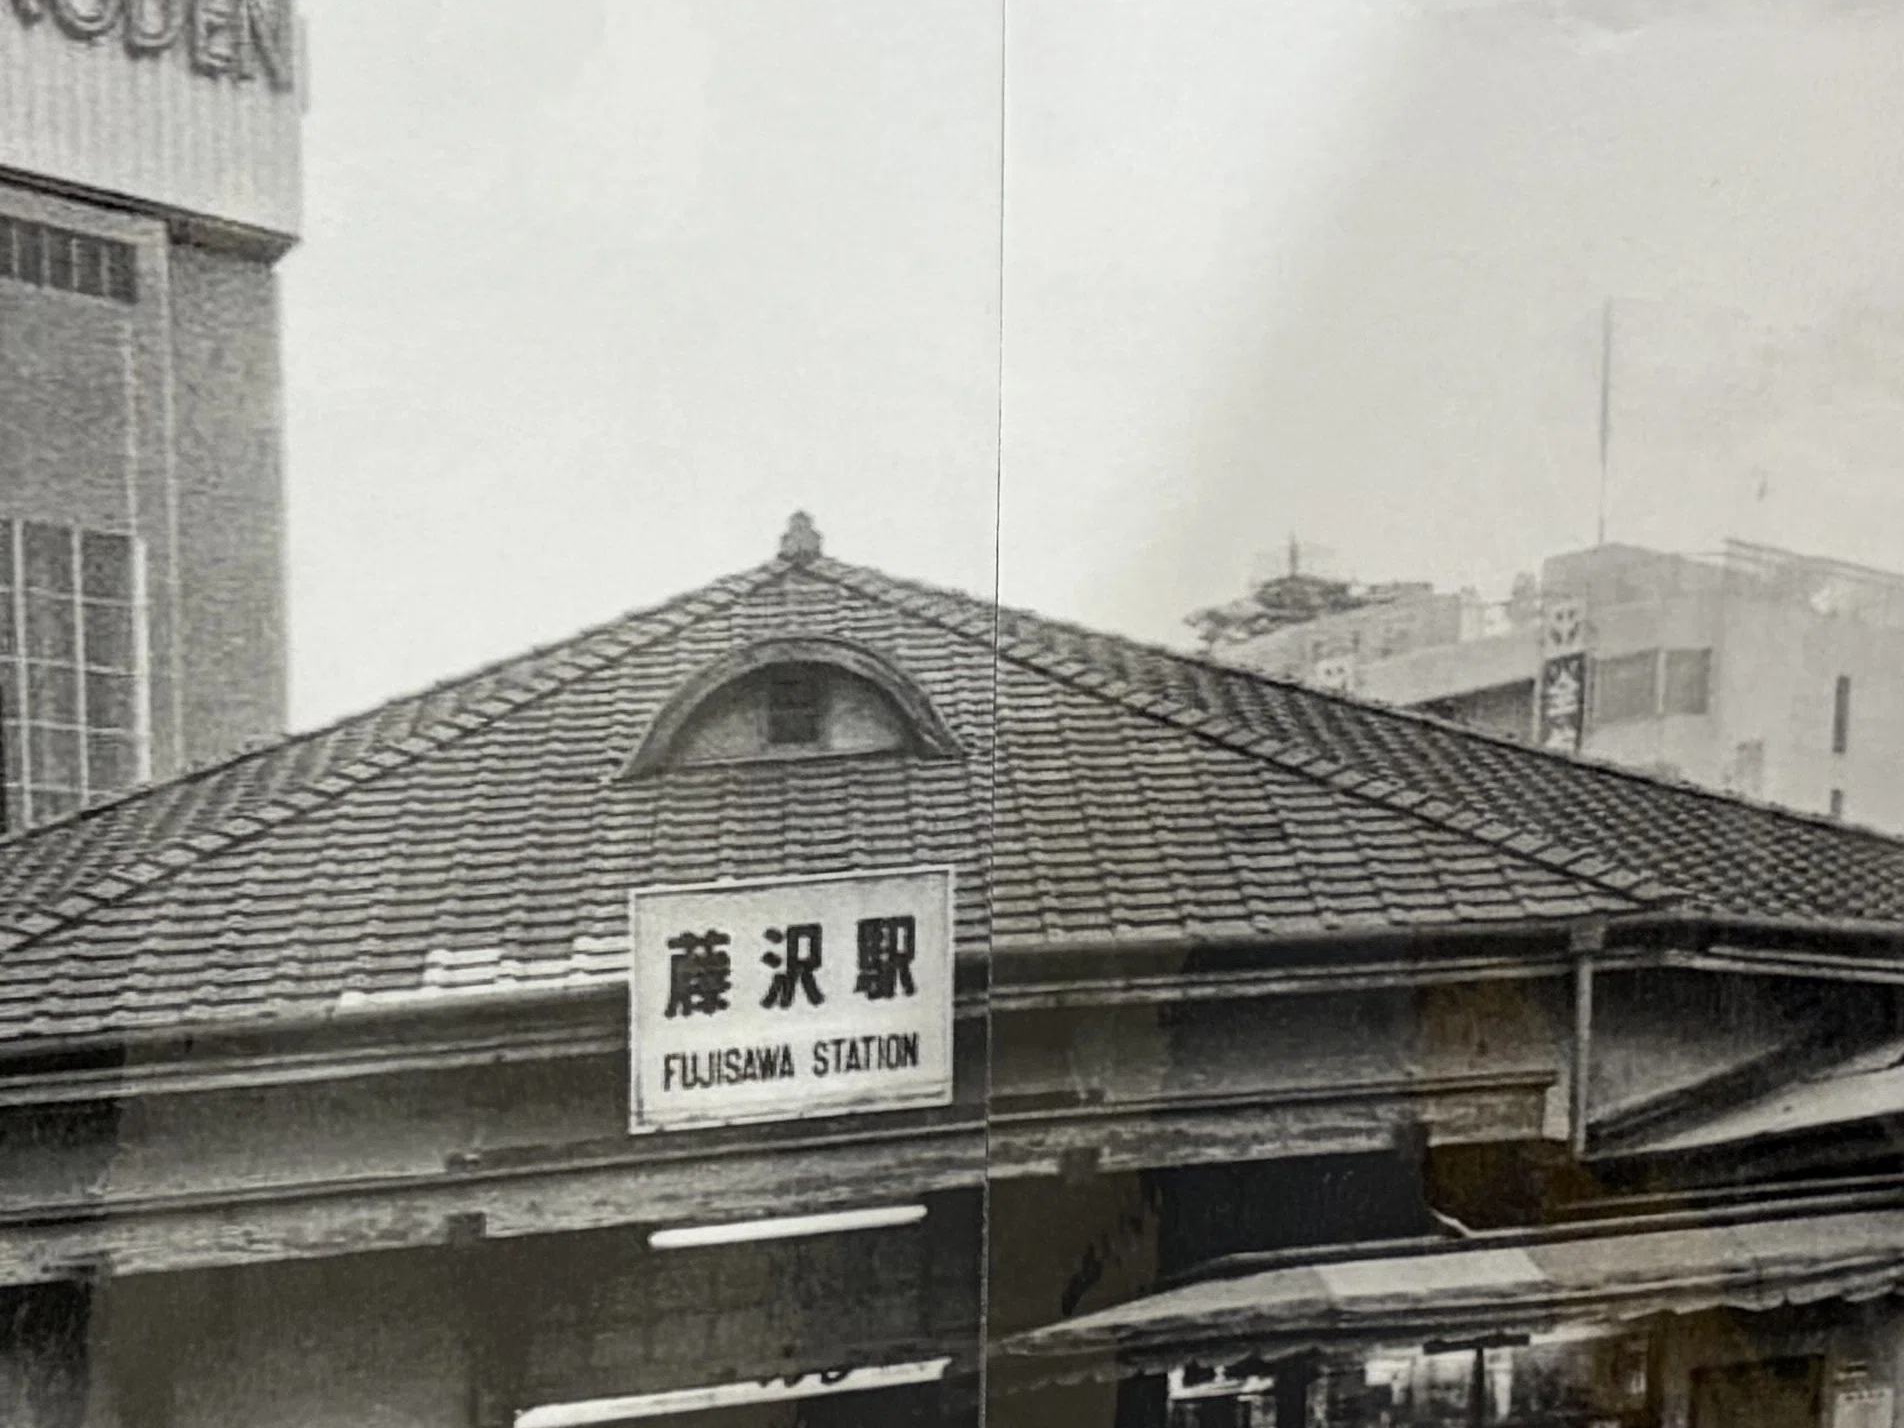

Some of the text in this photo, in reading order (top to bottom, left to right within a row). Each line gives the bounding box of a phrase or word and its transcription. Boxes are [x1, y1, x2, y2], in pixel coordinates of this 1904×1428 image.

[664, 915, 916, 1018] 藤沢駅
[664, 1032, 920, 1092] FUJISAWA STATION
